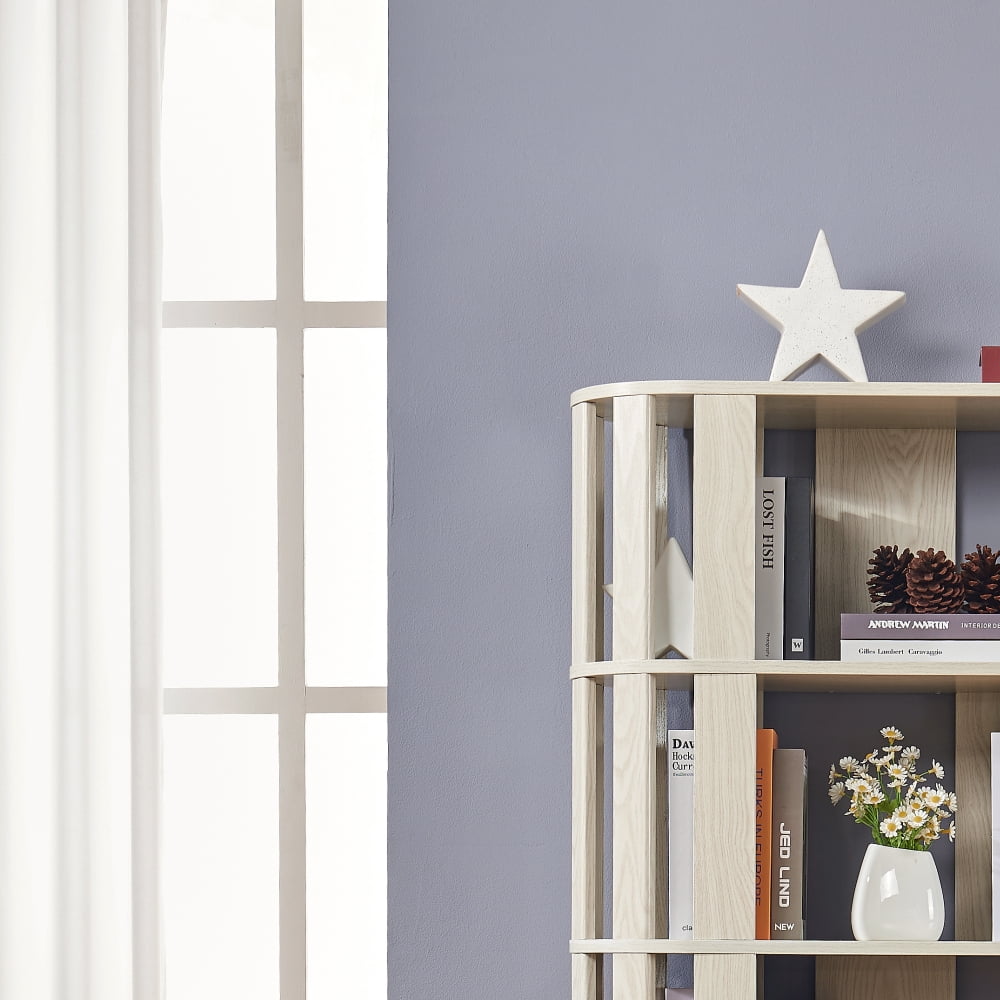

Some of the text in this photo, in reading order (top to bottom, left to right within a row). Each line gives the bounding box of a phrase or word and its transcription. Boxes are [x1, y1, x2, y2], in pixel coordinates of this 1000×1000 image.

[762, 490, 774, 569] LOST FISH
[868, 620, 950, 629] ANDREW MARTIN
[778, 823, 790, 908] JED LIND
